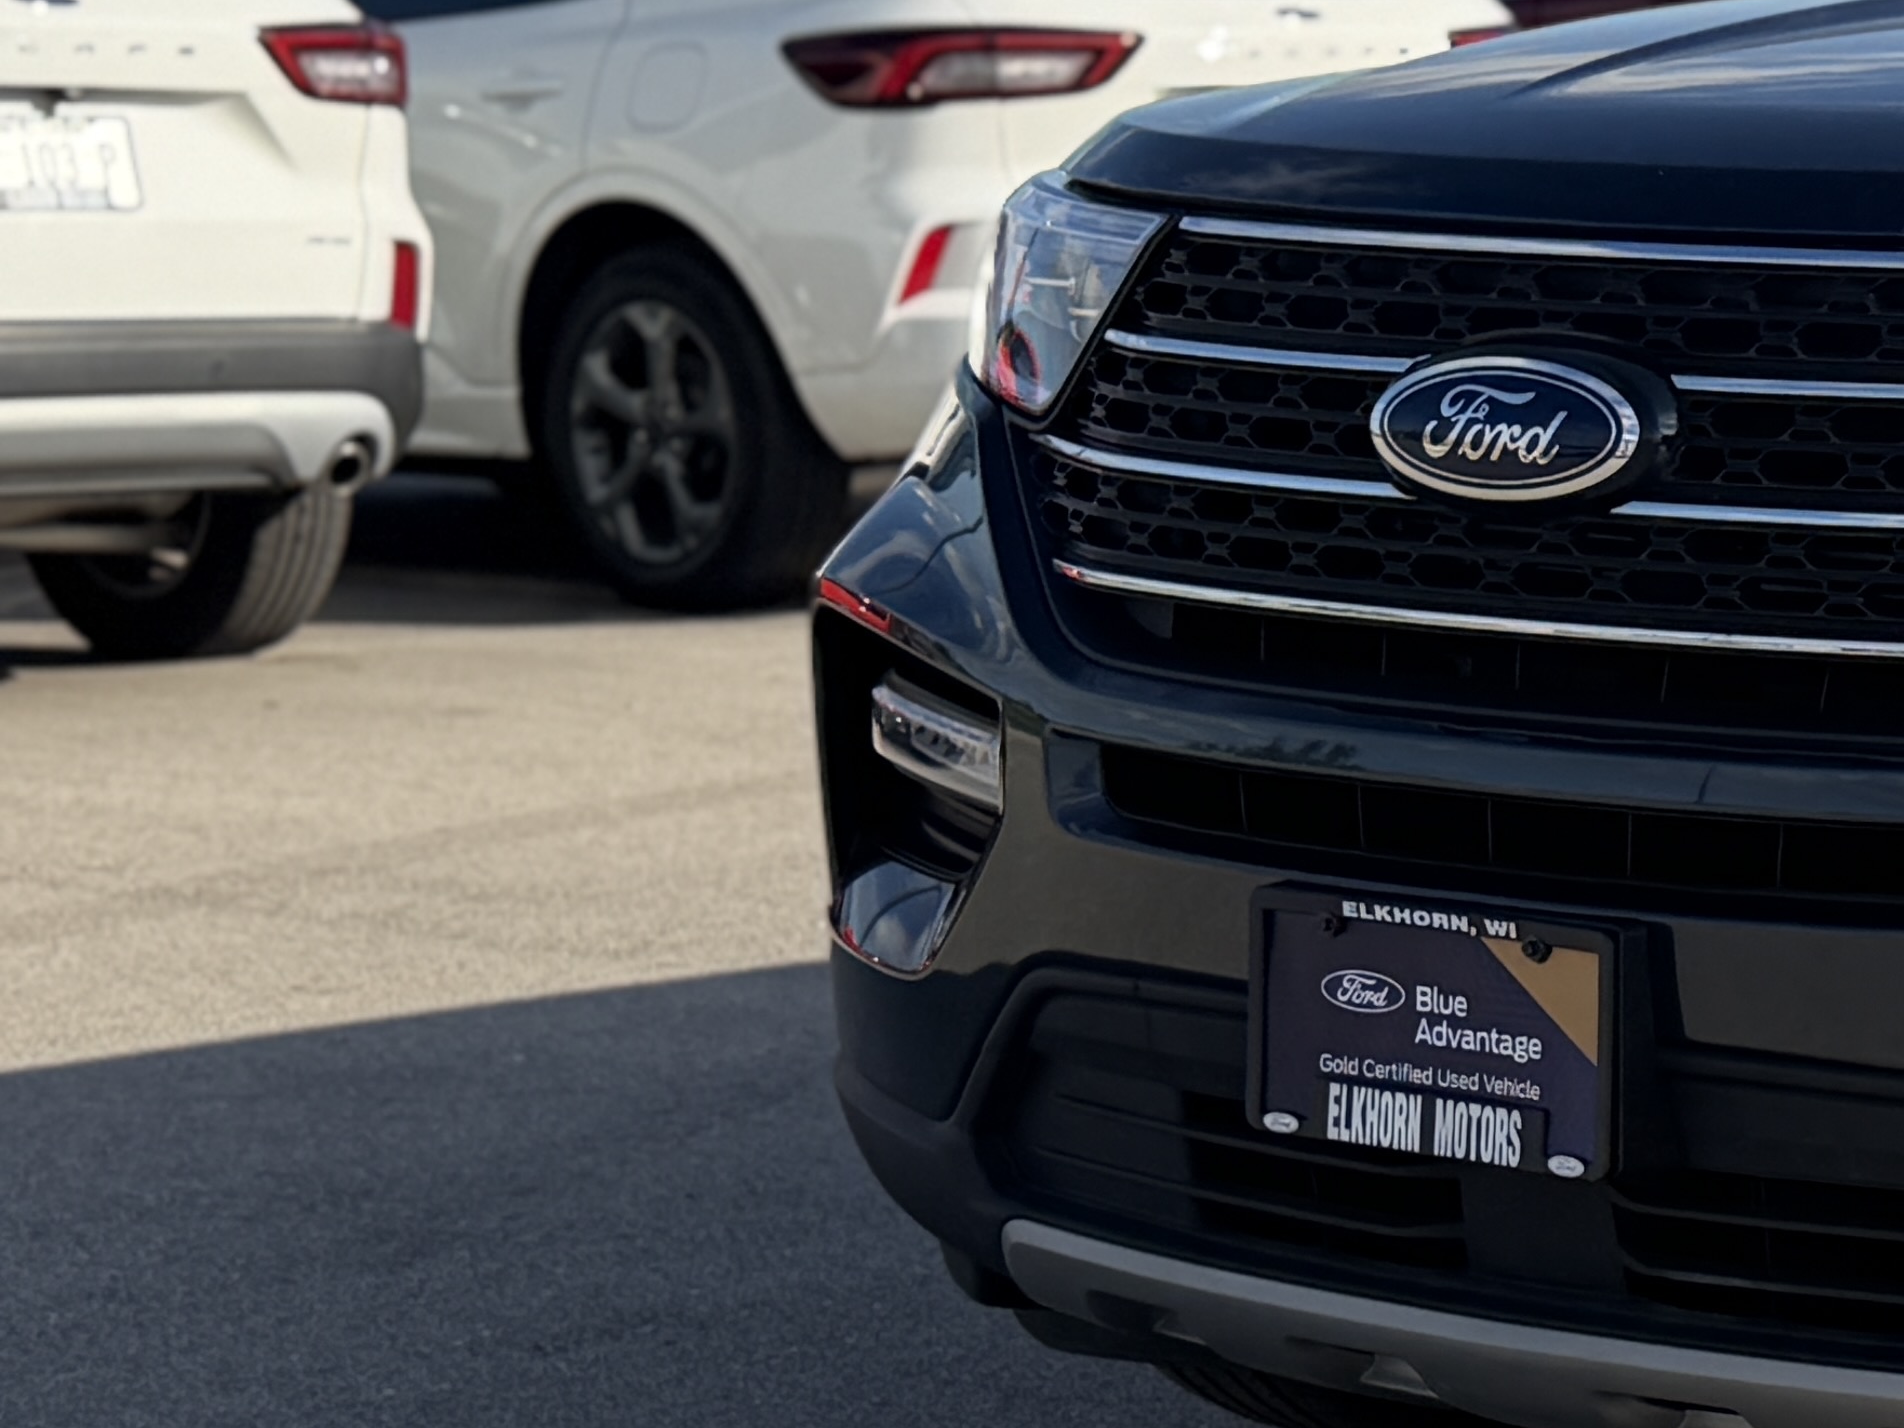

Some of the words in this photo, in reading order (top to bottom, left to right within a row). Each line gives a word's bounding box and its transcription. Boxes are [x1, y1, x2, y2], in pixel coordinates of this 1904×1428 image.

[1423, 384, 1568, 465] Ford
[1342, 901, 1478, 937] ELKHORN,
[1484, 919, 1518, 939] WI
[1336, 973, 1390, 1009] Ford
[1415, 985, 1468, 1018] Blue
[1415, 1018, 1543, 1063] Advantage
[1319, 1053, 1359, 1076] Gold
[1362, 1058, 1433, 1086] Certified
[1437, 1069, 1480, 1092] Used
[1483, 1075, 1541, 1101] Vehicle
[1327, 1082, 1422, 1154] ELKHORN
[1433, 1097, 1523, 1168] MOTORS
